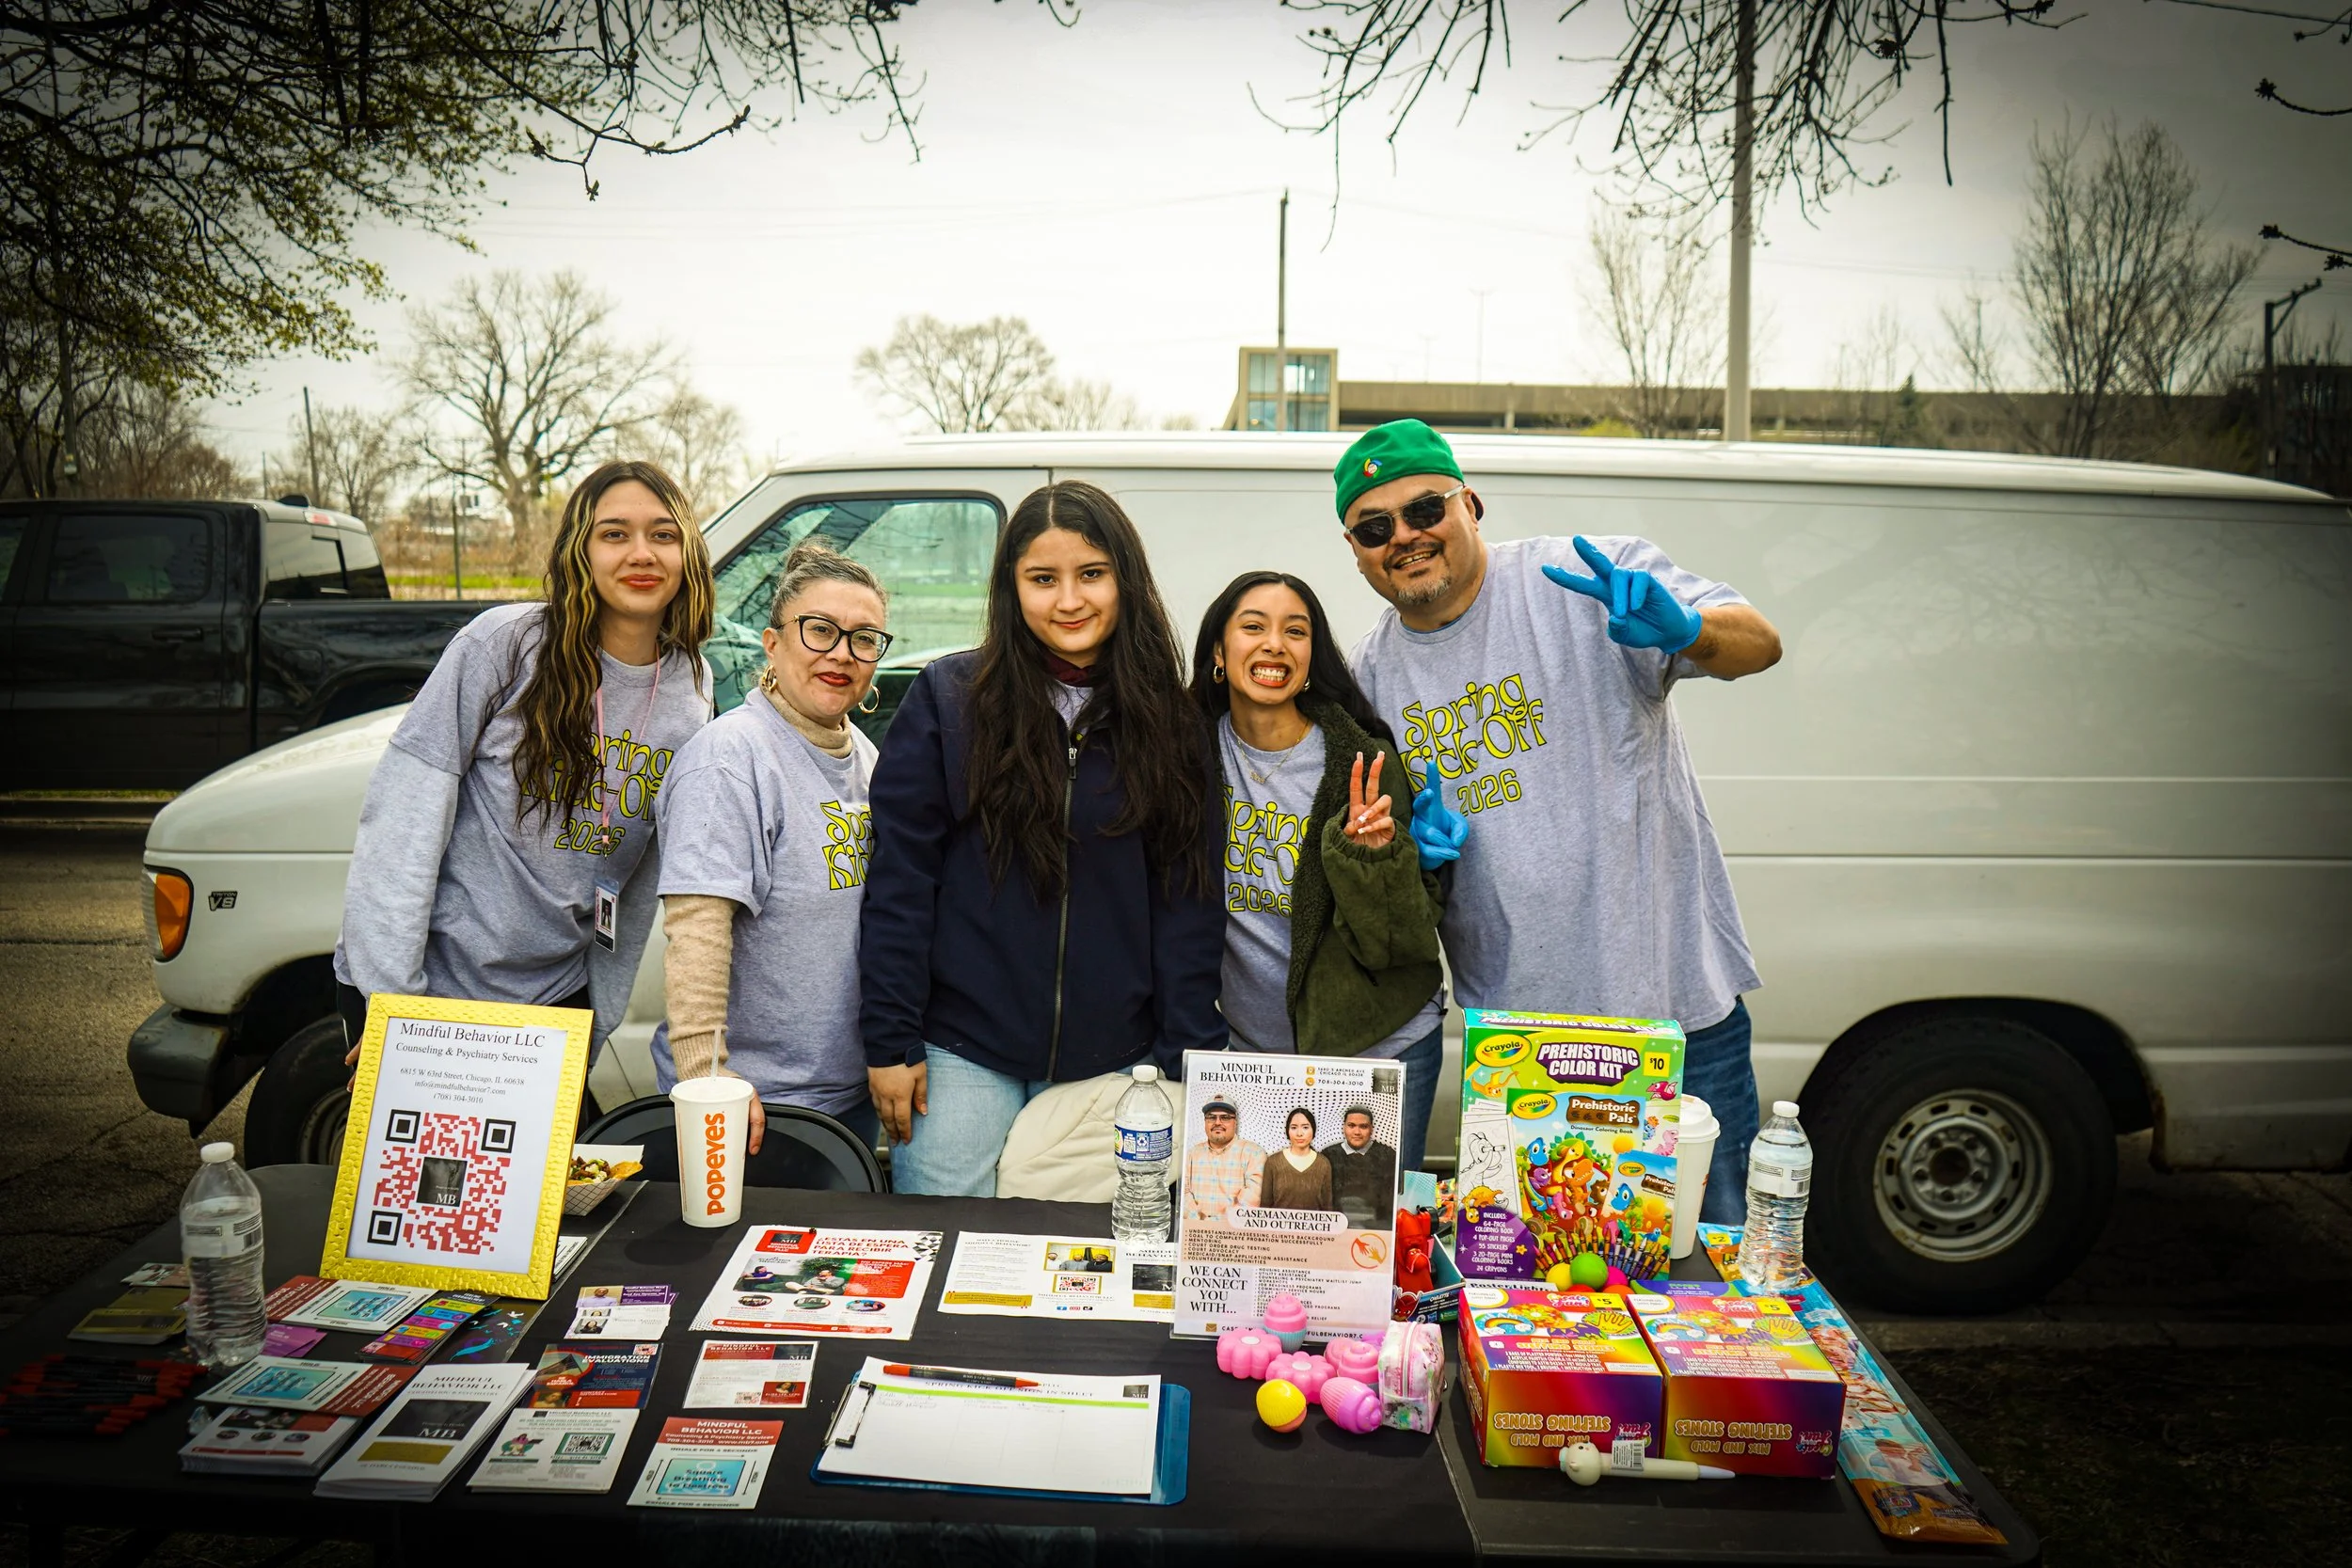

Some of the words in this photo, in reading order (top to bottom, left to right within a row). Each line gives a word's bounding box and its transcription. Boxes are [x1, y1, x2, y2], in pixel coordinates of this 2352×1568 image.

[1403, 673, 1529, 752] Spring
[591, 729, 674, 778] ring
[1457, 768, 1521, 816] 2026
[1224, 784, 1311, 844] prin
[209, 895, 235, 911] V8
[1228, 882, 1293, 917] 2026
[400, 1022, 451, 1039] Mindful
[454, 1028, 512, 1045] Behavior
[515, 1033, 545, 1047] LLC
[396, 1042, 443, 1056] Counseling
[456, 1049, 500, 1062] Psychiatry
[501, 1053, 538, 1064] Services
[1485, 1041, 1521, 1053] Crayola
[1538, 1044, 1639, 1067] PREHISTORIC
[1221, 1063, 1276, 1074] MINDFUL
[1549, 1060, 1597, 1076] COLOR
[1600, 1062, 1624, 1080] KIT
[1650, 1057, 1664, 1069] $10
[1200, 1071, 1262, 1084] BEHAVIOR
[1267, 1075, 1295, 1085] PLLC
[1519, 1099, 1549, 1108] Crayola
[1571, 1099, 1635, 1113] Prehistoric
[1609, 1113, 1634, 1124] Pals
[437, 1193, 456, 1204] MB
[1236, 1209, 1341, 1223] CASEMANAGEMENT
[1245, 1219, 1267, 1227] AND
[1271, 1221, 1331, 1232] OUTREACH
[1190, 1265, 1213, 1277] WE
[1214, 1266, 1241, 1278] CAN
[1182, 1276, 1248, 1291] CONNECT
[1200, 1290, 1229, 1302] YOU
[1493, 1413, 1544, 1430] STONES
[1547, 1415, 1612, 1433] STEPPING
[1675, 1419, 1724, 1437] STONES
[418, 1429, 457, 1438] MB
[1728, 1422, 1793, 1440] STEPPING
[1510, 1433, 1540, 1447] MOLD
[1542, 1434, 1565, 1448] AND
[1691, 1440, 1721, 1453] MOLD
[1723, 1441, 1746, 1454] AND
[1748, 1442, 1771, 1455] MIX
